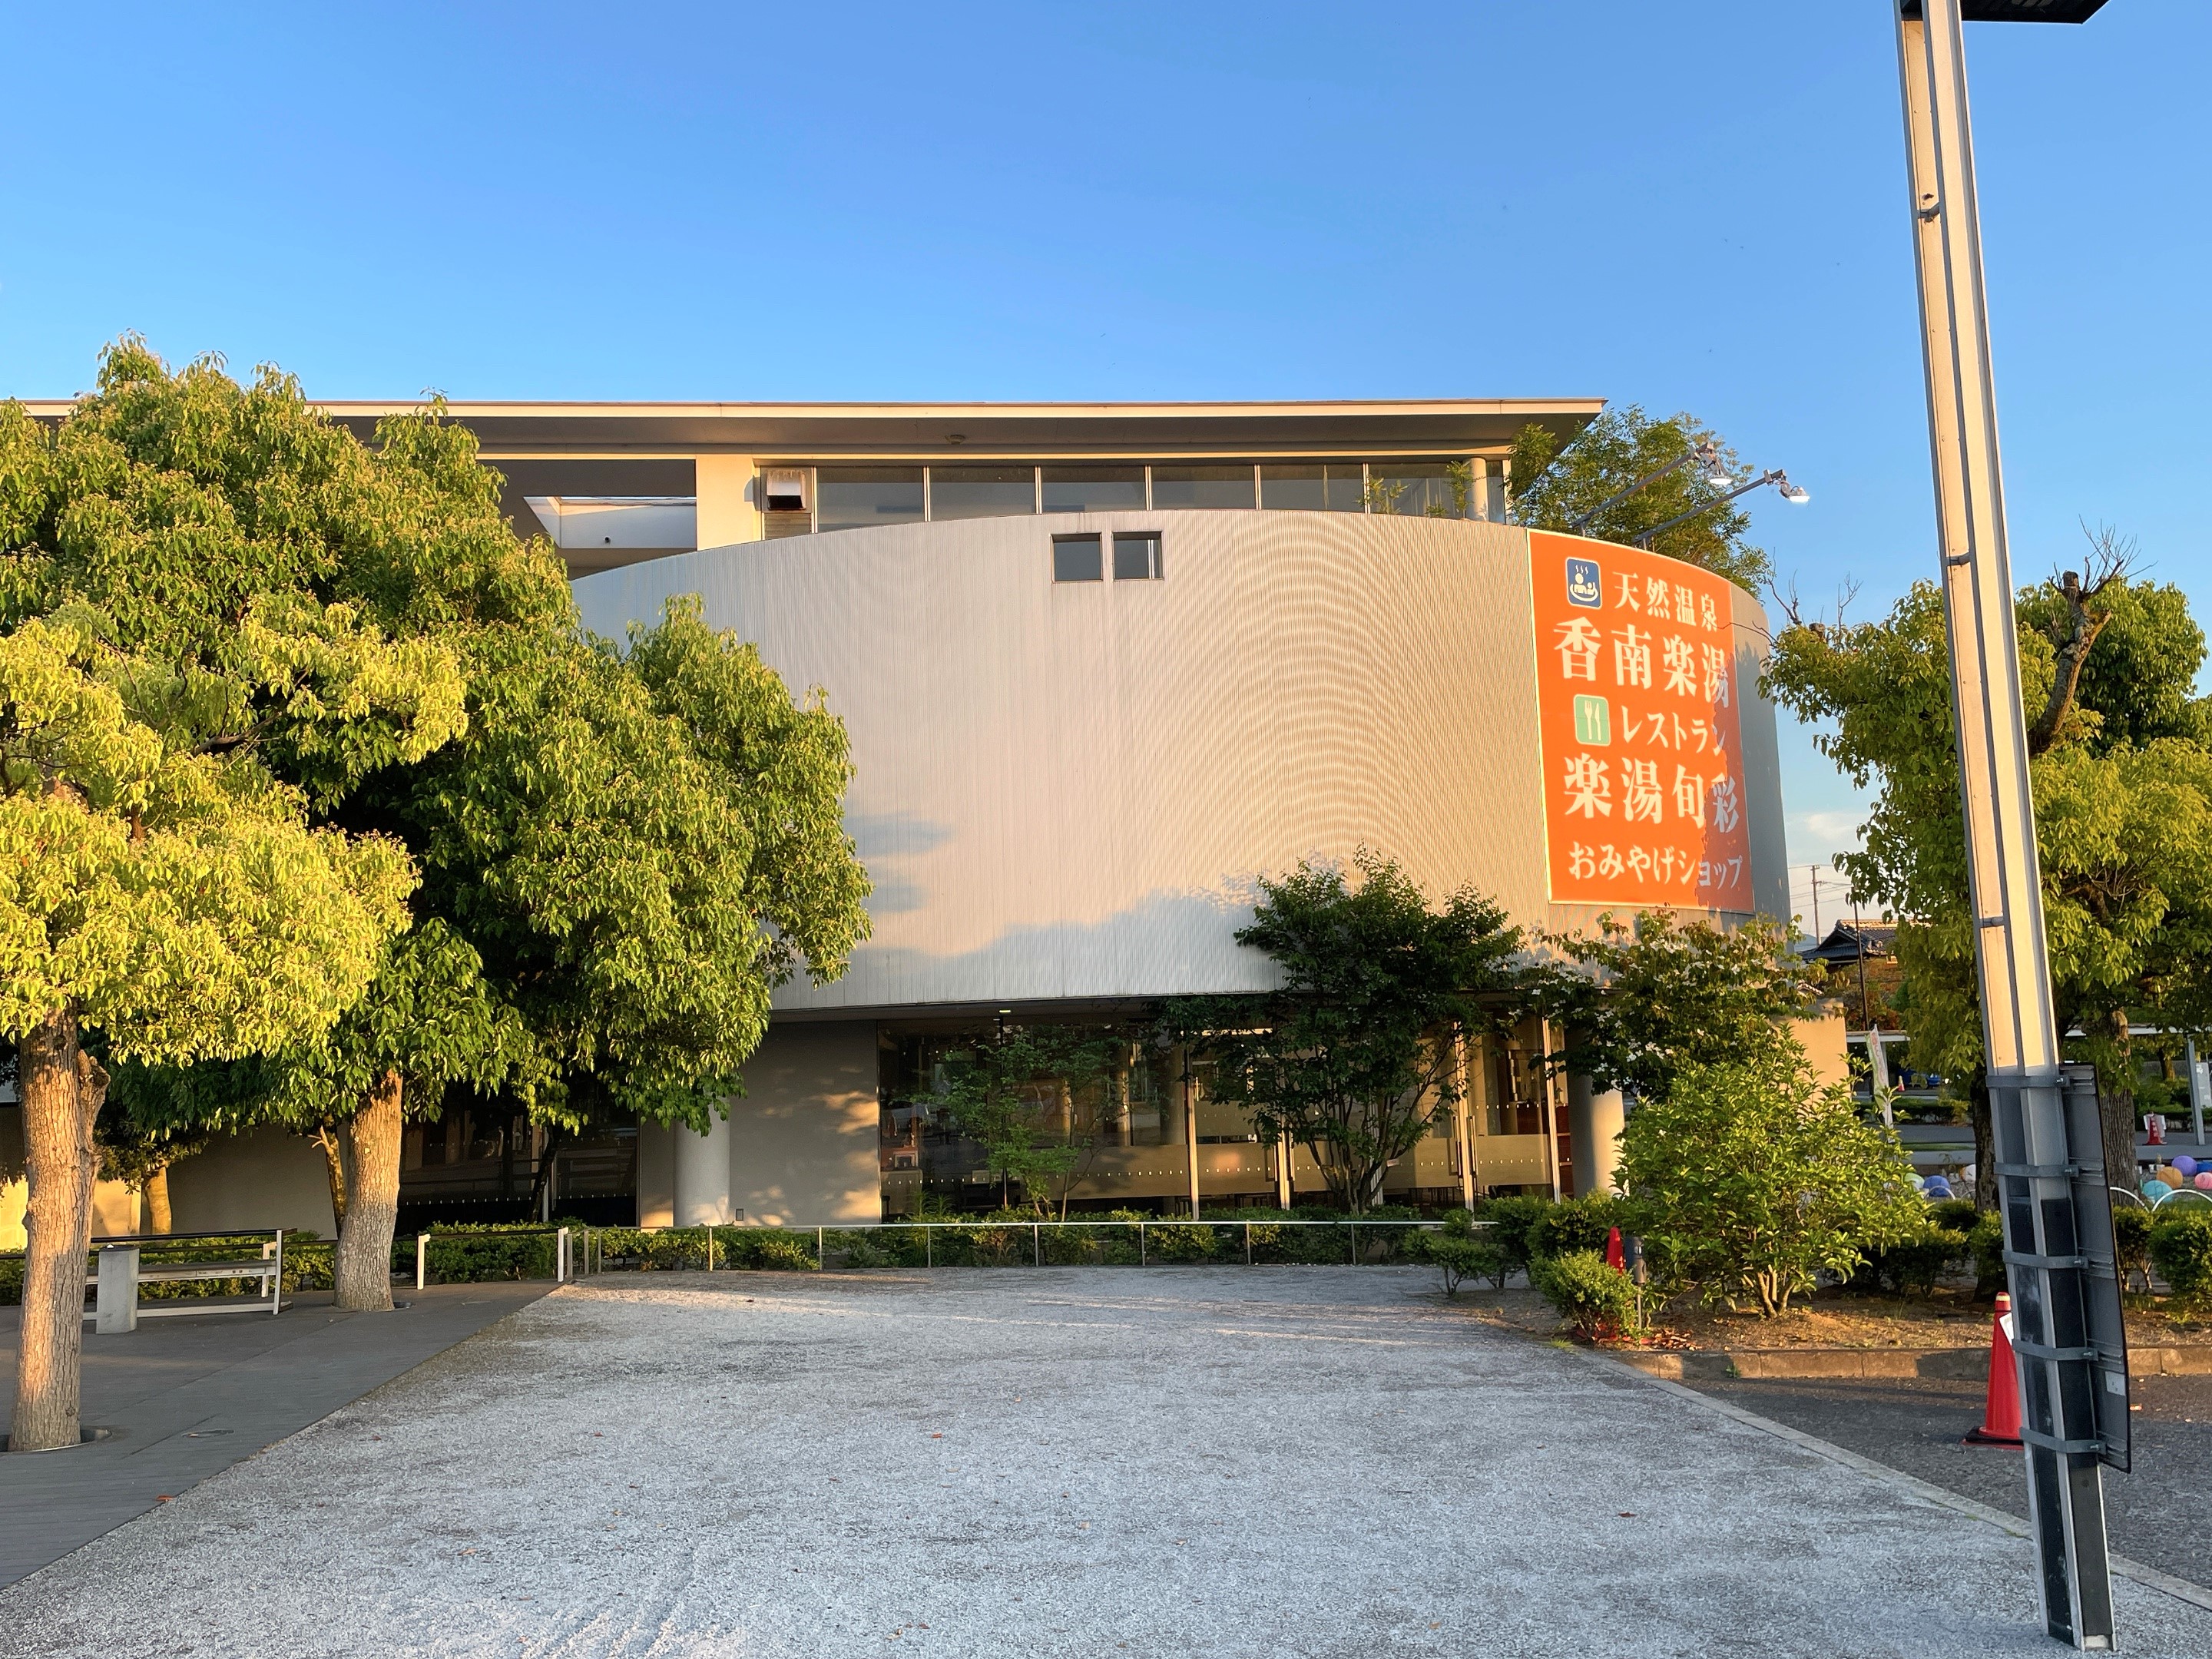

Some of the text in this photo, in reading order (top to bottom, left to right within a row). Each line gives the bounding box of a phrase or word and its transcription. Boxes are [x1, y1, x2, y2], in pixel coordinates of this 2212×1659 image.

[1613, 571, 1717, 632] 天然温泉
[1554, 617, 1728, 707] 香南楽湯
[1621, 705, 1726, 756] レストラン
[1564, 753, 1739, 833] 楽湯旬彩
[1569, 841, 1743, 889] おみやげショップ
